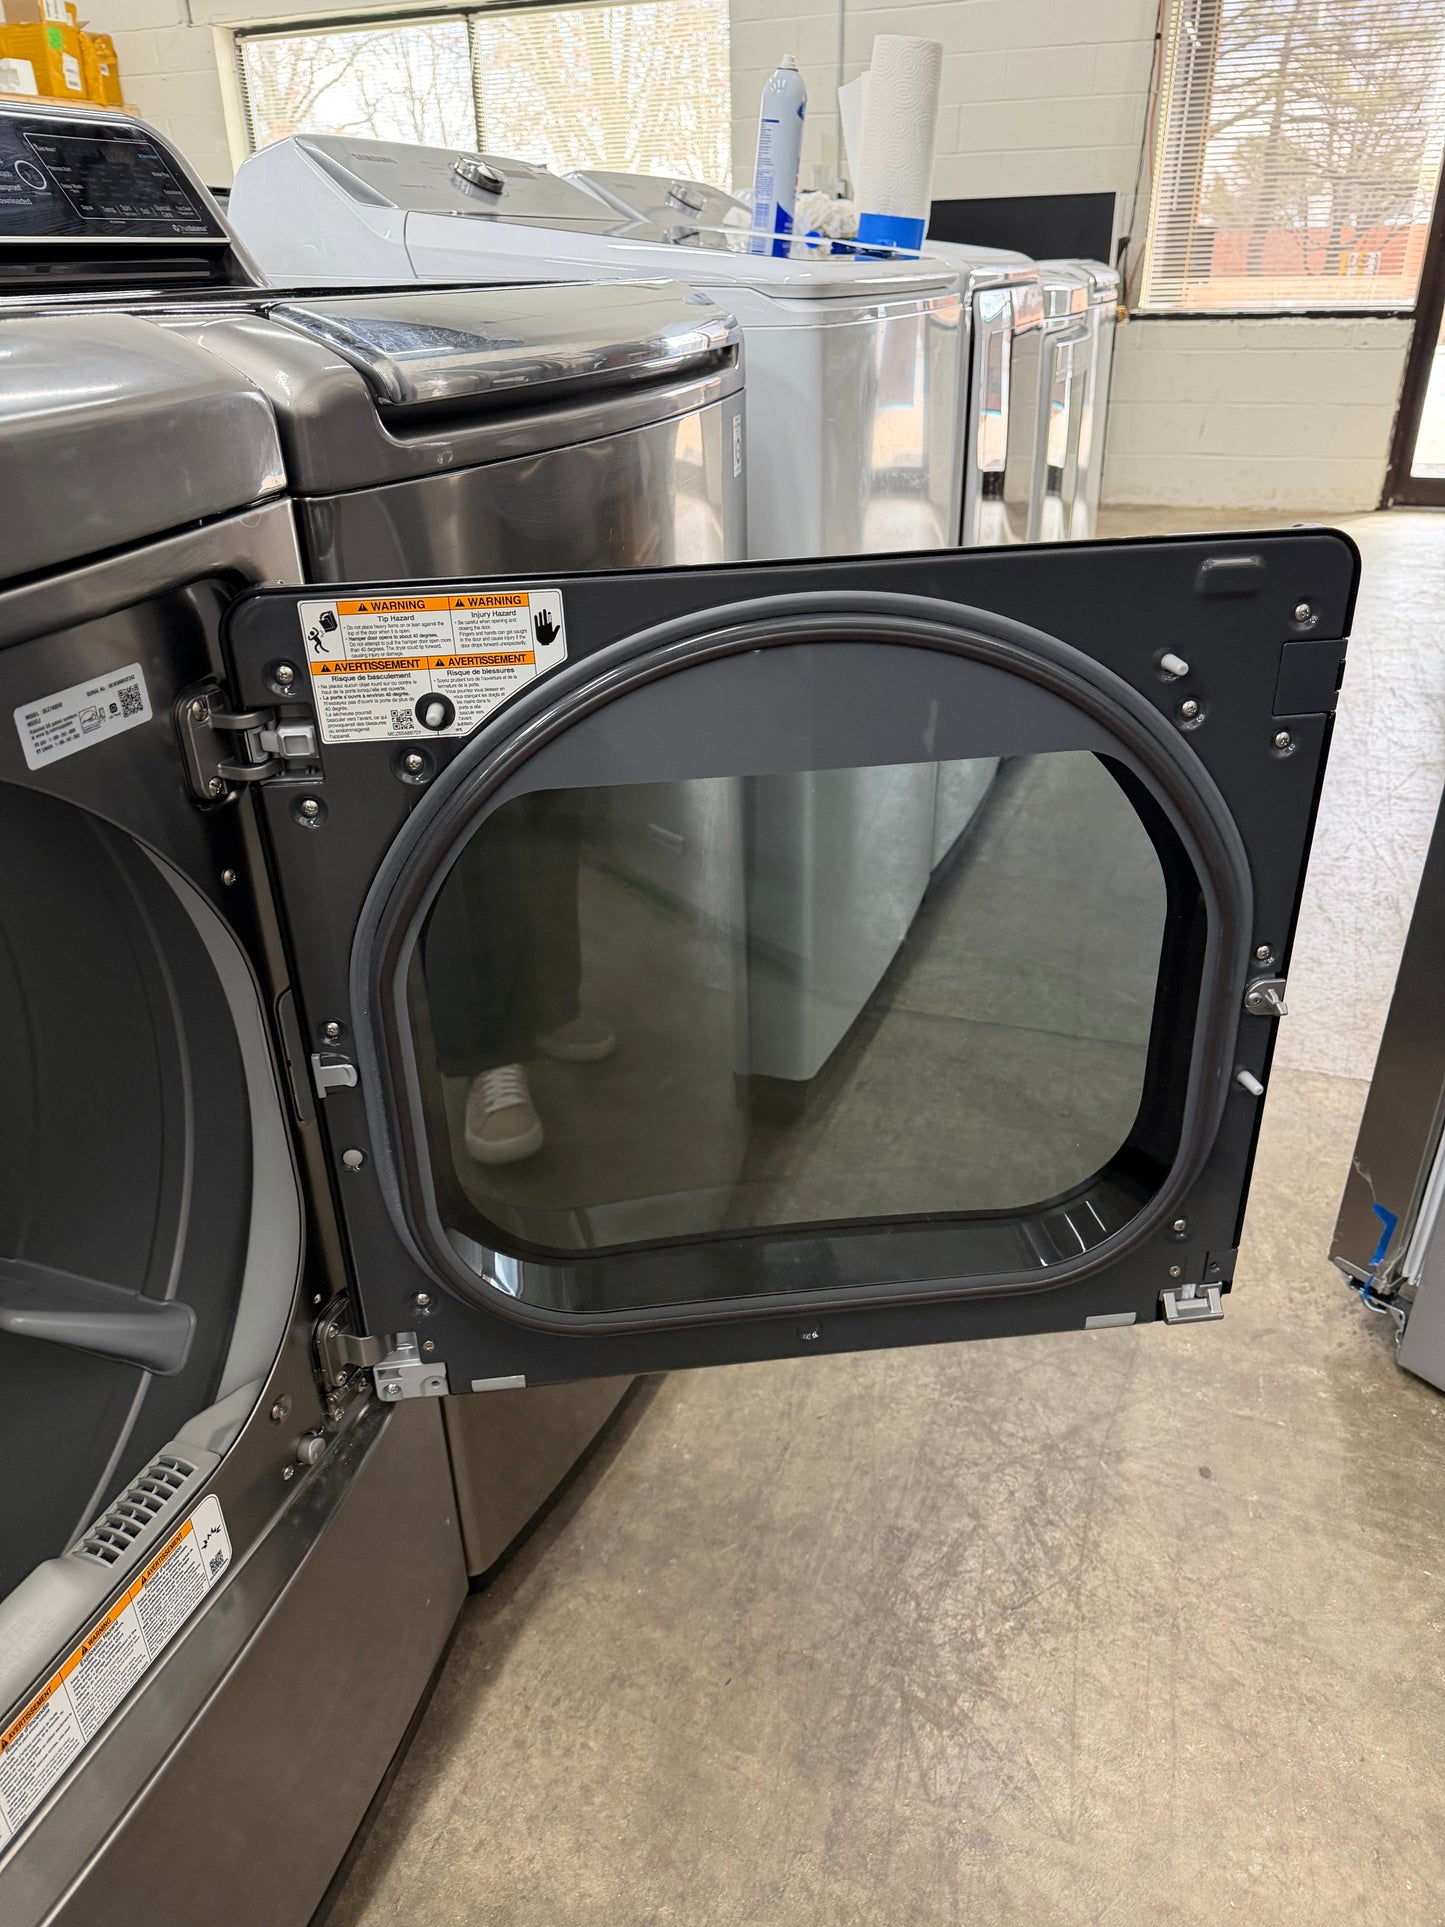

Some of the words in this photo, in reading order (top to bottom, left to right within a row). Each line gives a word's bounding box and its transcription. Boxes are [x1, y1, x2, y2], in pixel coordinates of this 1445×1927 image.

[371, 600, 425, 611] WARNING
[467, 595, 521, 607] WARNING
[377, 615, 389, 623] Tip
[471, 611, 491, 619] Injury
[334, 659, 420, 672] AVERTISSEMENT
[448, 654, 526, 666] AVERTISSEMENT
[331, 675, 356, 683] Risque
[146, 1532, 183, 1577] AVERTISSEMENT
[87, 1617, 112, 1646] WARNING
[8, 1687, 53, 1739] AVERTISSEMENT
